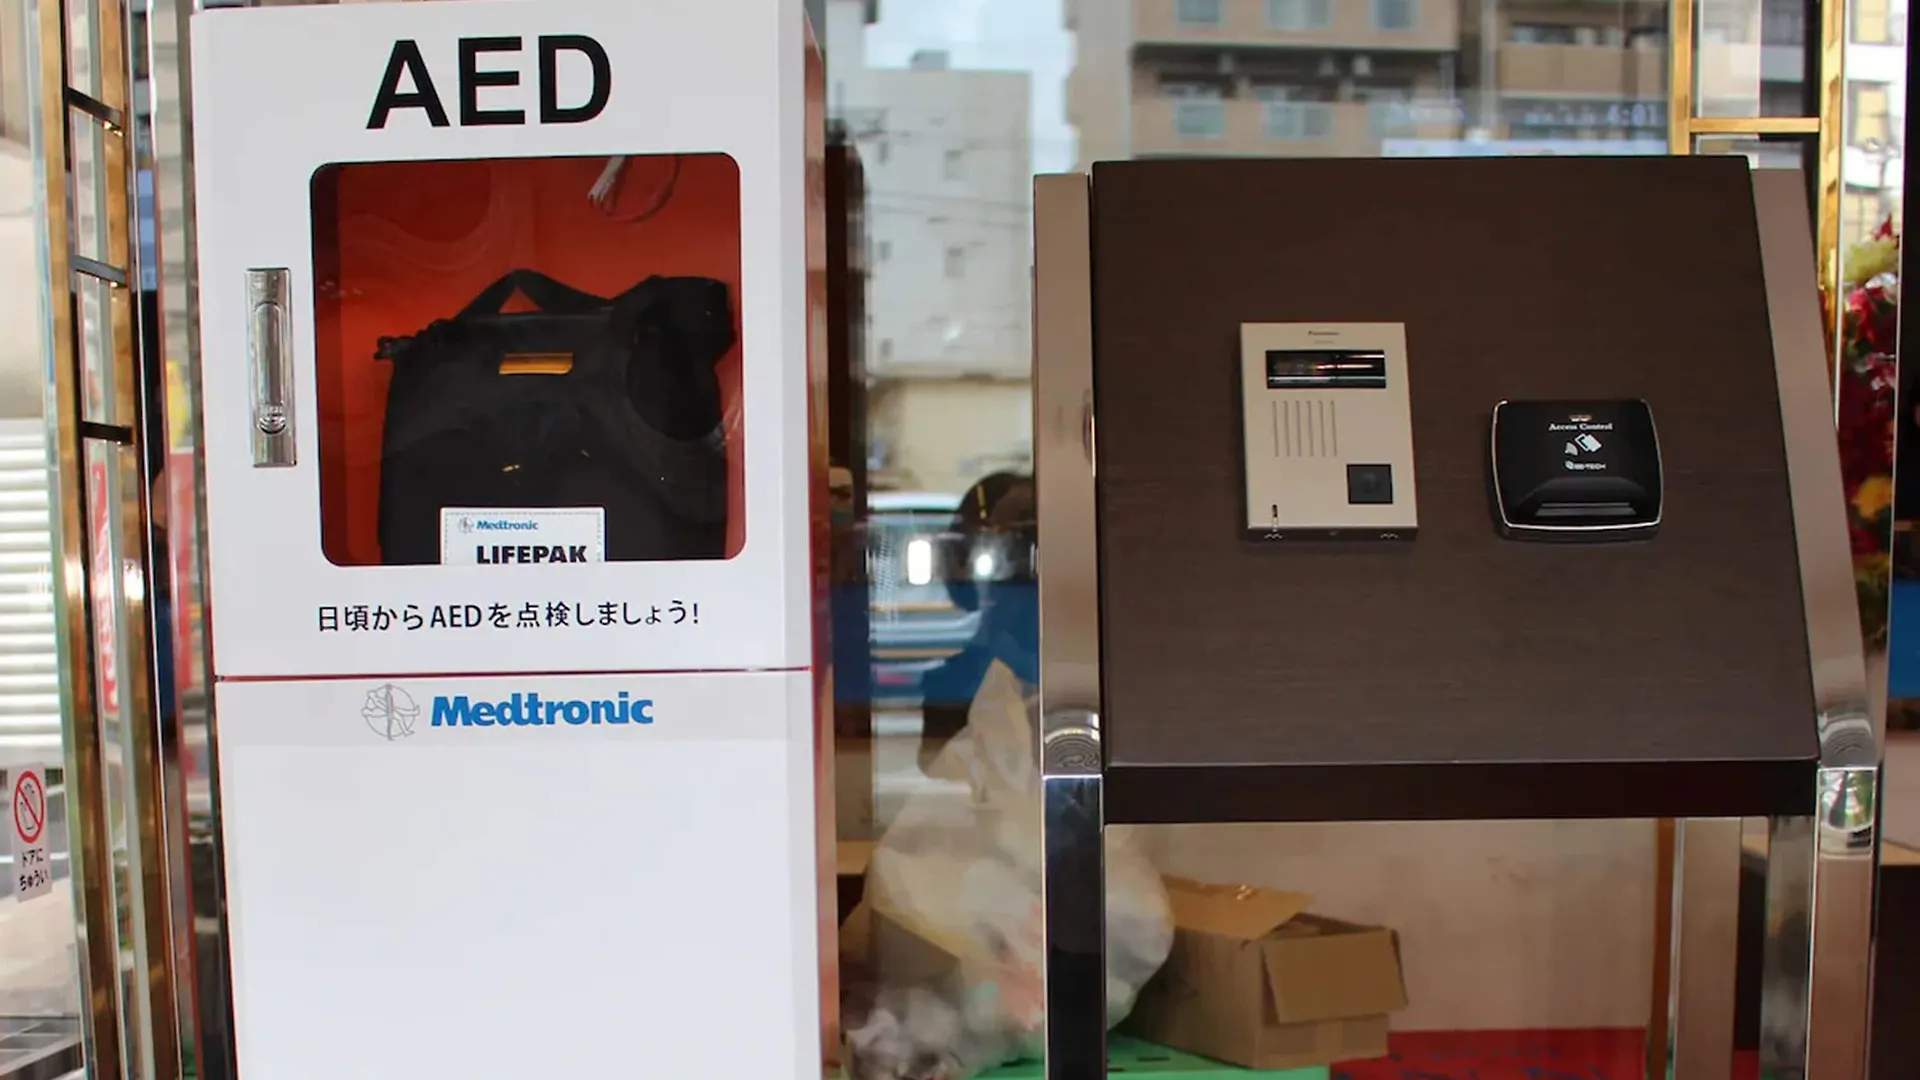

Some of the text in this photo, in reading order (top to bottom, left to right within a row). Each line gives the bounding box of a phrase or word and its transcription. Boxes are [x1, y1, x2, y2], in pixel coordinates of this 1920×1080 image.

[366, 34, 612, 130] AED
[1548, 423, 1613, 431] Access Control
[476, 519, 539, 531] Medtronic
[476, 545, 587, 565] LIFEPAK
[317, 600, 700, 632] 日頃からAEDを点検しましょう!
[430, 691, 654, 727] Medtronic
[21, 848, 43, 868] ドアに
